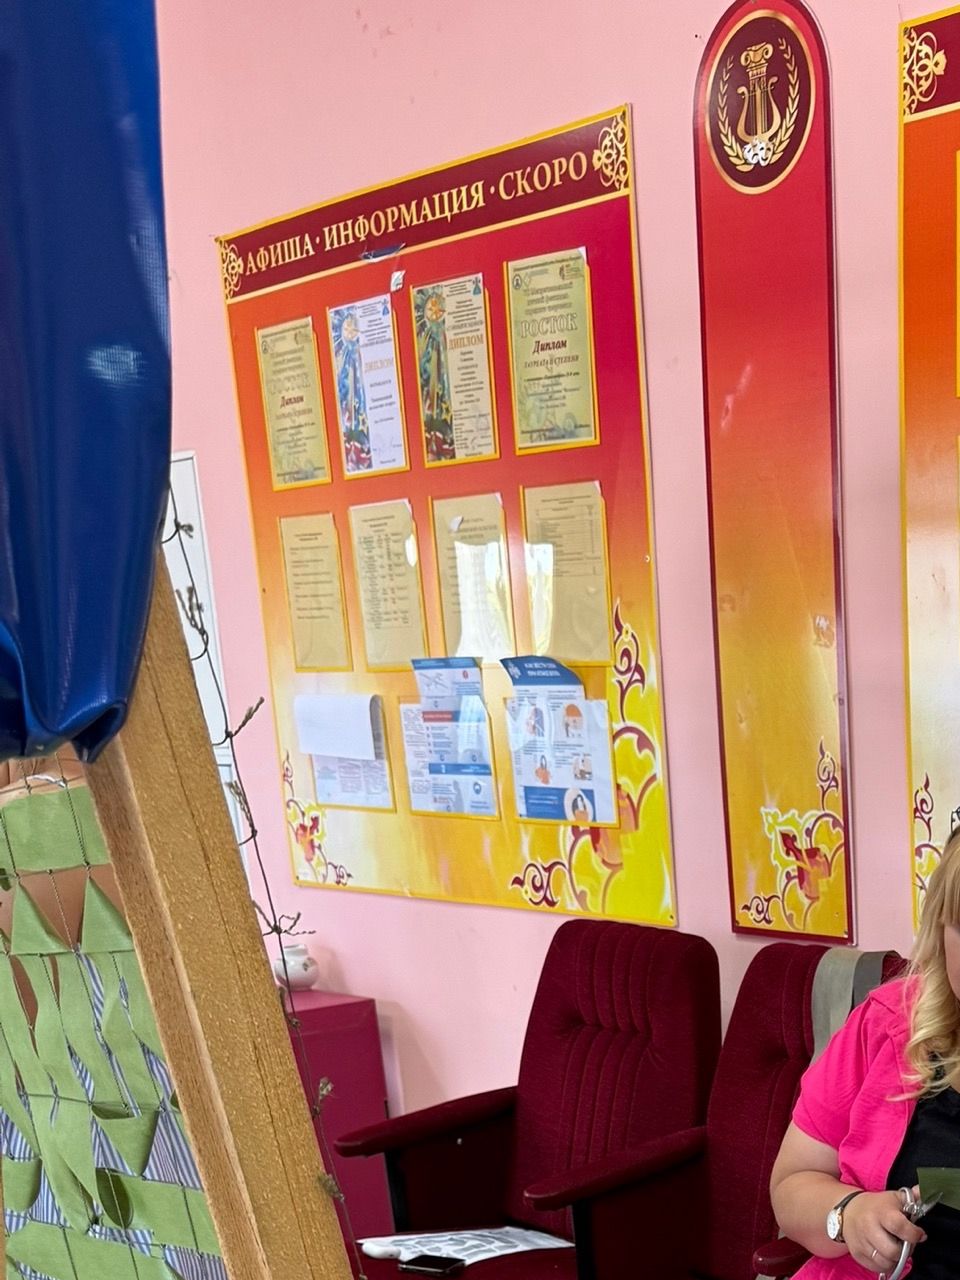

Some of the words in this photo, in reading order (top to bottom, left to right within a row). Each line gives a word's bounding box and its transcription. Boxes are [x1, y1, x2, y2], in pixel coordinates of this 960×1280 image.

[245, 233, 315, 275] АФИША
[322, 180, 485, 251] ИНФОРМАЦИЯ
[499, 151, 587, 200] СКОРО
[520, 312, 578, 338] РОСТОК
[532, 340, 567, 354] Диплом
